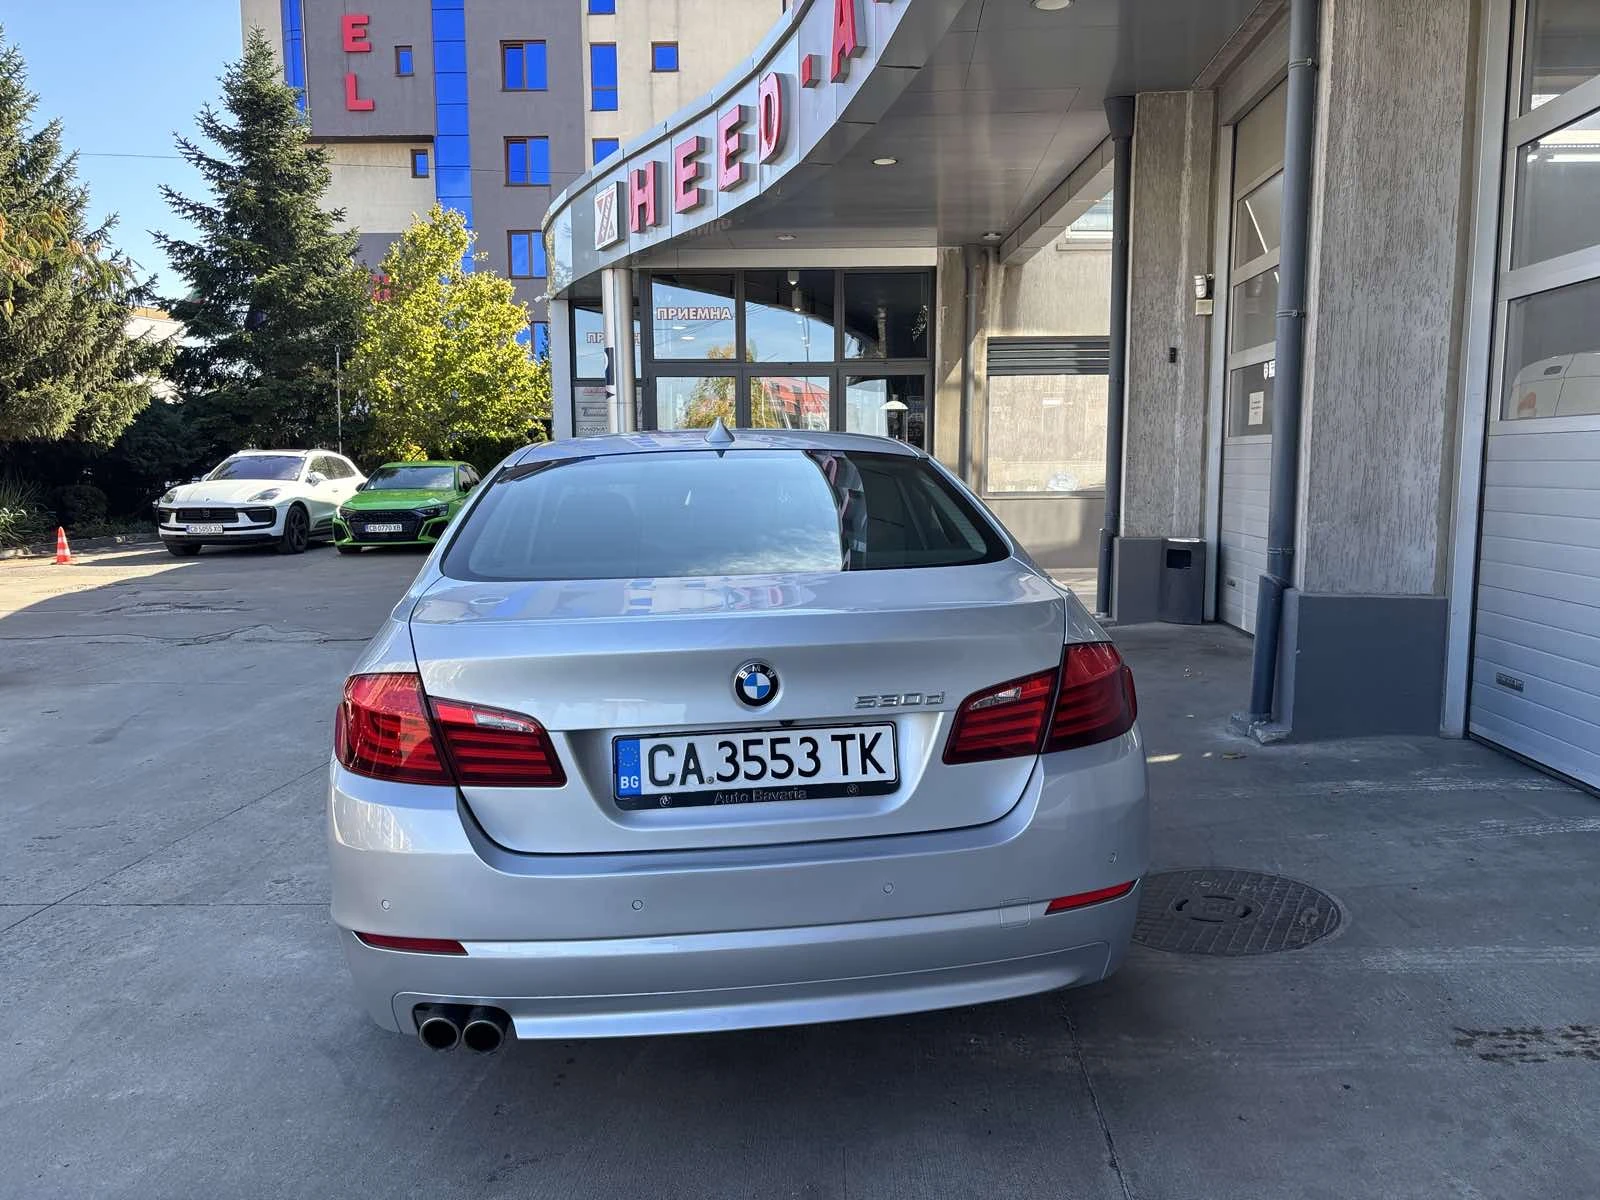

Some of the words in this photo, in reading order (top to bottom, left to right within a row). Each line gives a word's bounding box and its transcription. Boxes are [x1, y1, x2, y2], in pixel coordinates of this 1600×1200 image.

[656, 307, 733, 321] ПРИЕМНА
[738, 665, 776, 680] BMW
[854, 691, 945, 710] 530d
[647, 743, 705, 787] CA
[716, 736, 822, 783] 3553
[831, 732, 886, 777] TK
[620, 775, 640, 790] BG
[714, 791, 749, 805] Auto
[752, 787, 808, 803] Bavaria
